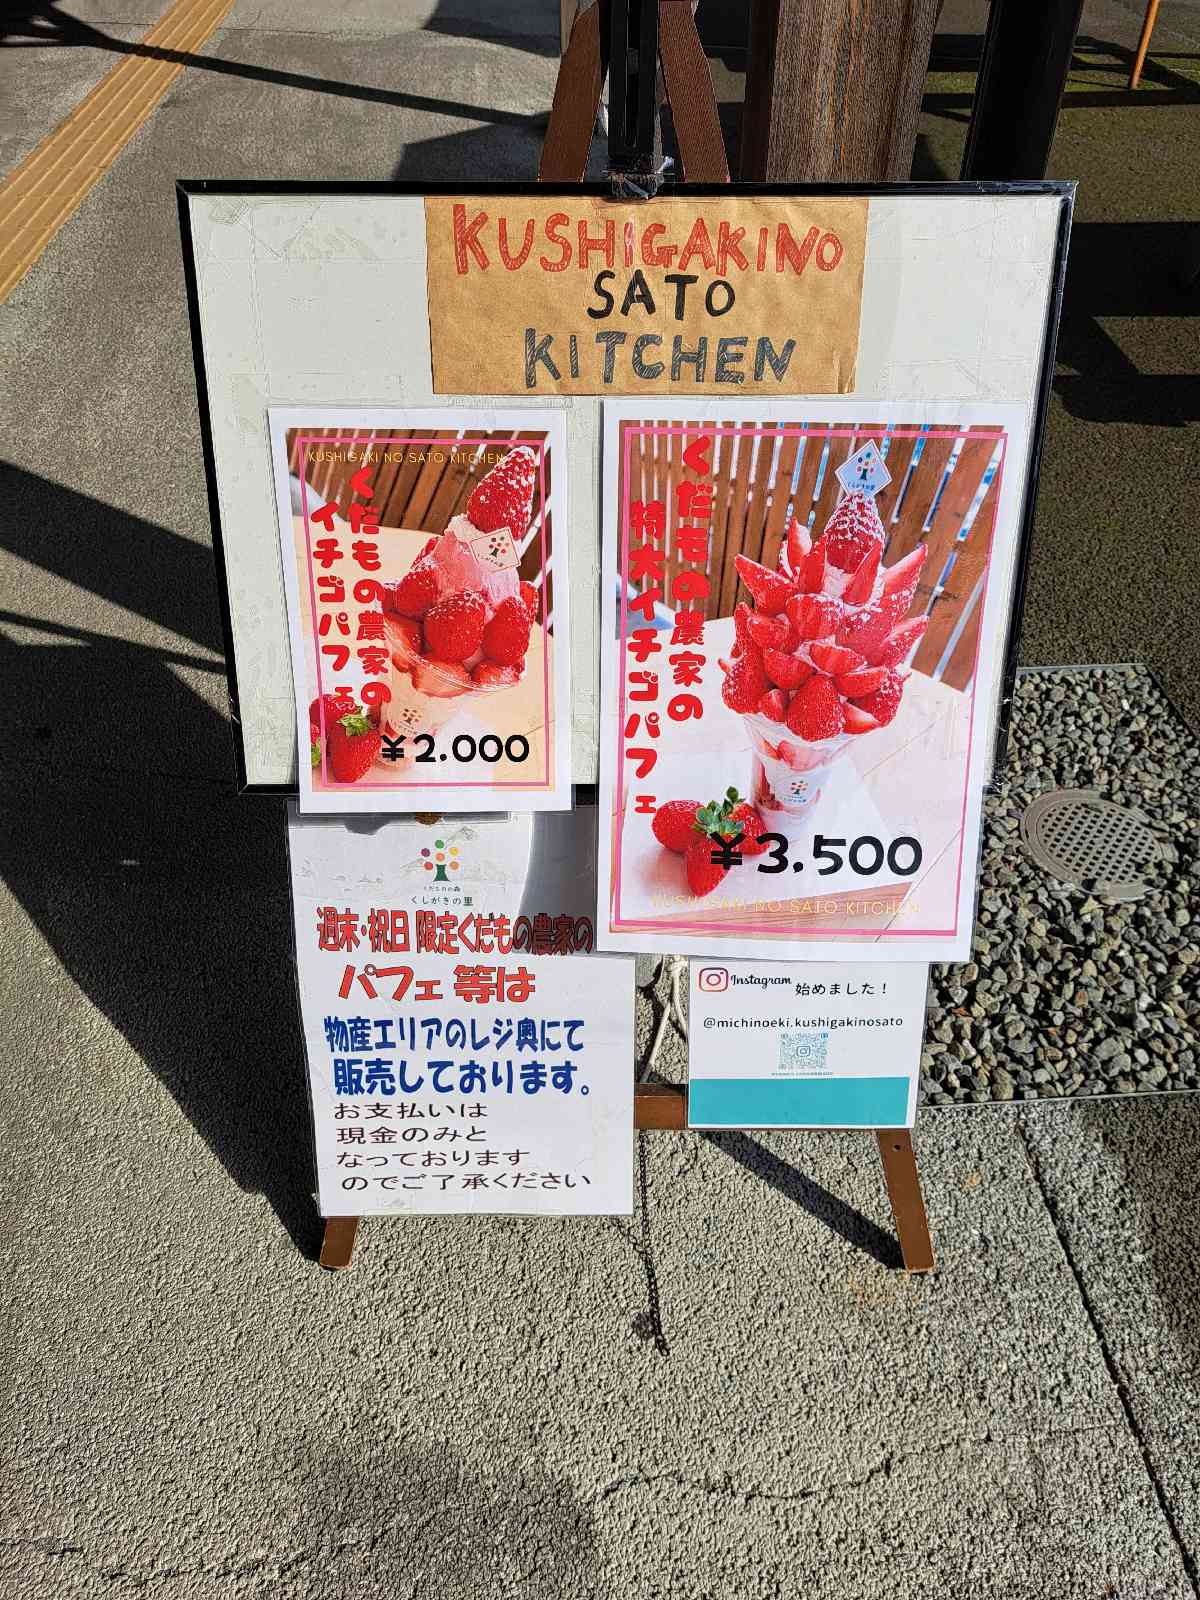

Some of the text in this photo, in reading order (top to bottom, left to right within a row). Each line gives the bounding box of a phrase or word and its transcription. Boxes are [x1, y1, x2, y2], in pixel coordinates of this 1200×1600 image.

[453, 203, 844, 276] KUSHIGAKINO
[587, 269, 736, 320] SATO
[524, 328, 797, 388] KITCHEN
[384, 452, 404, 463] NO
[409, 452, 444, 463] SATO
[349, 466, 392, 706] くだもの農家の
[667, 436, 713, 721] くだもの農家の
[311, 503, 354, 703] イチゴパフェ
[625, 500, 665, 814] 特大イチゴパフェ
[338, 963, 536, 1004] パフェ 等は
[730, 973, 792, 990] Instagram
[324, 1016, 585, 1053] 物産エリアのレジ奥にて
[703, 1016, 904, 1030] @michinoeki.kushigakinosato
[333, 1058, 590, 1097] 販売しております。
[334, 1102, 488, 1120] お支払いは
[335, 1126, 488, 1145] 現金のみと
[336, 1148, 530, 1168] なっております
[341, 1171, 592, 1191] のでご了承ください
